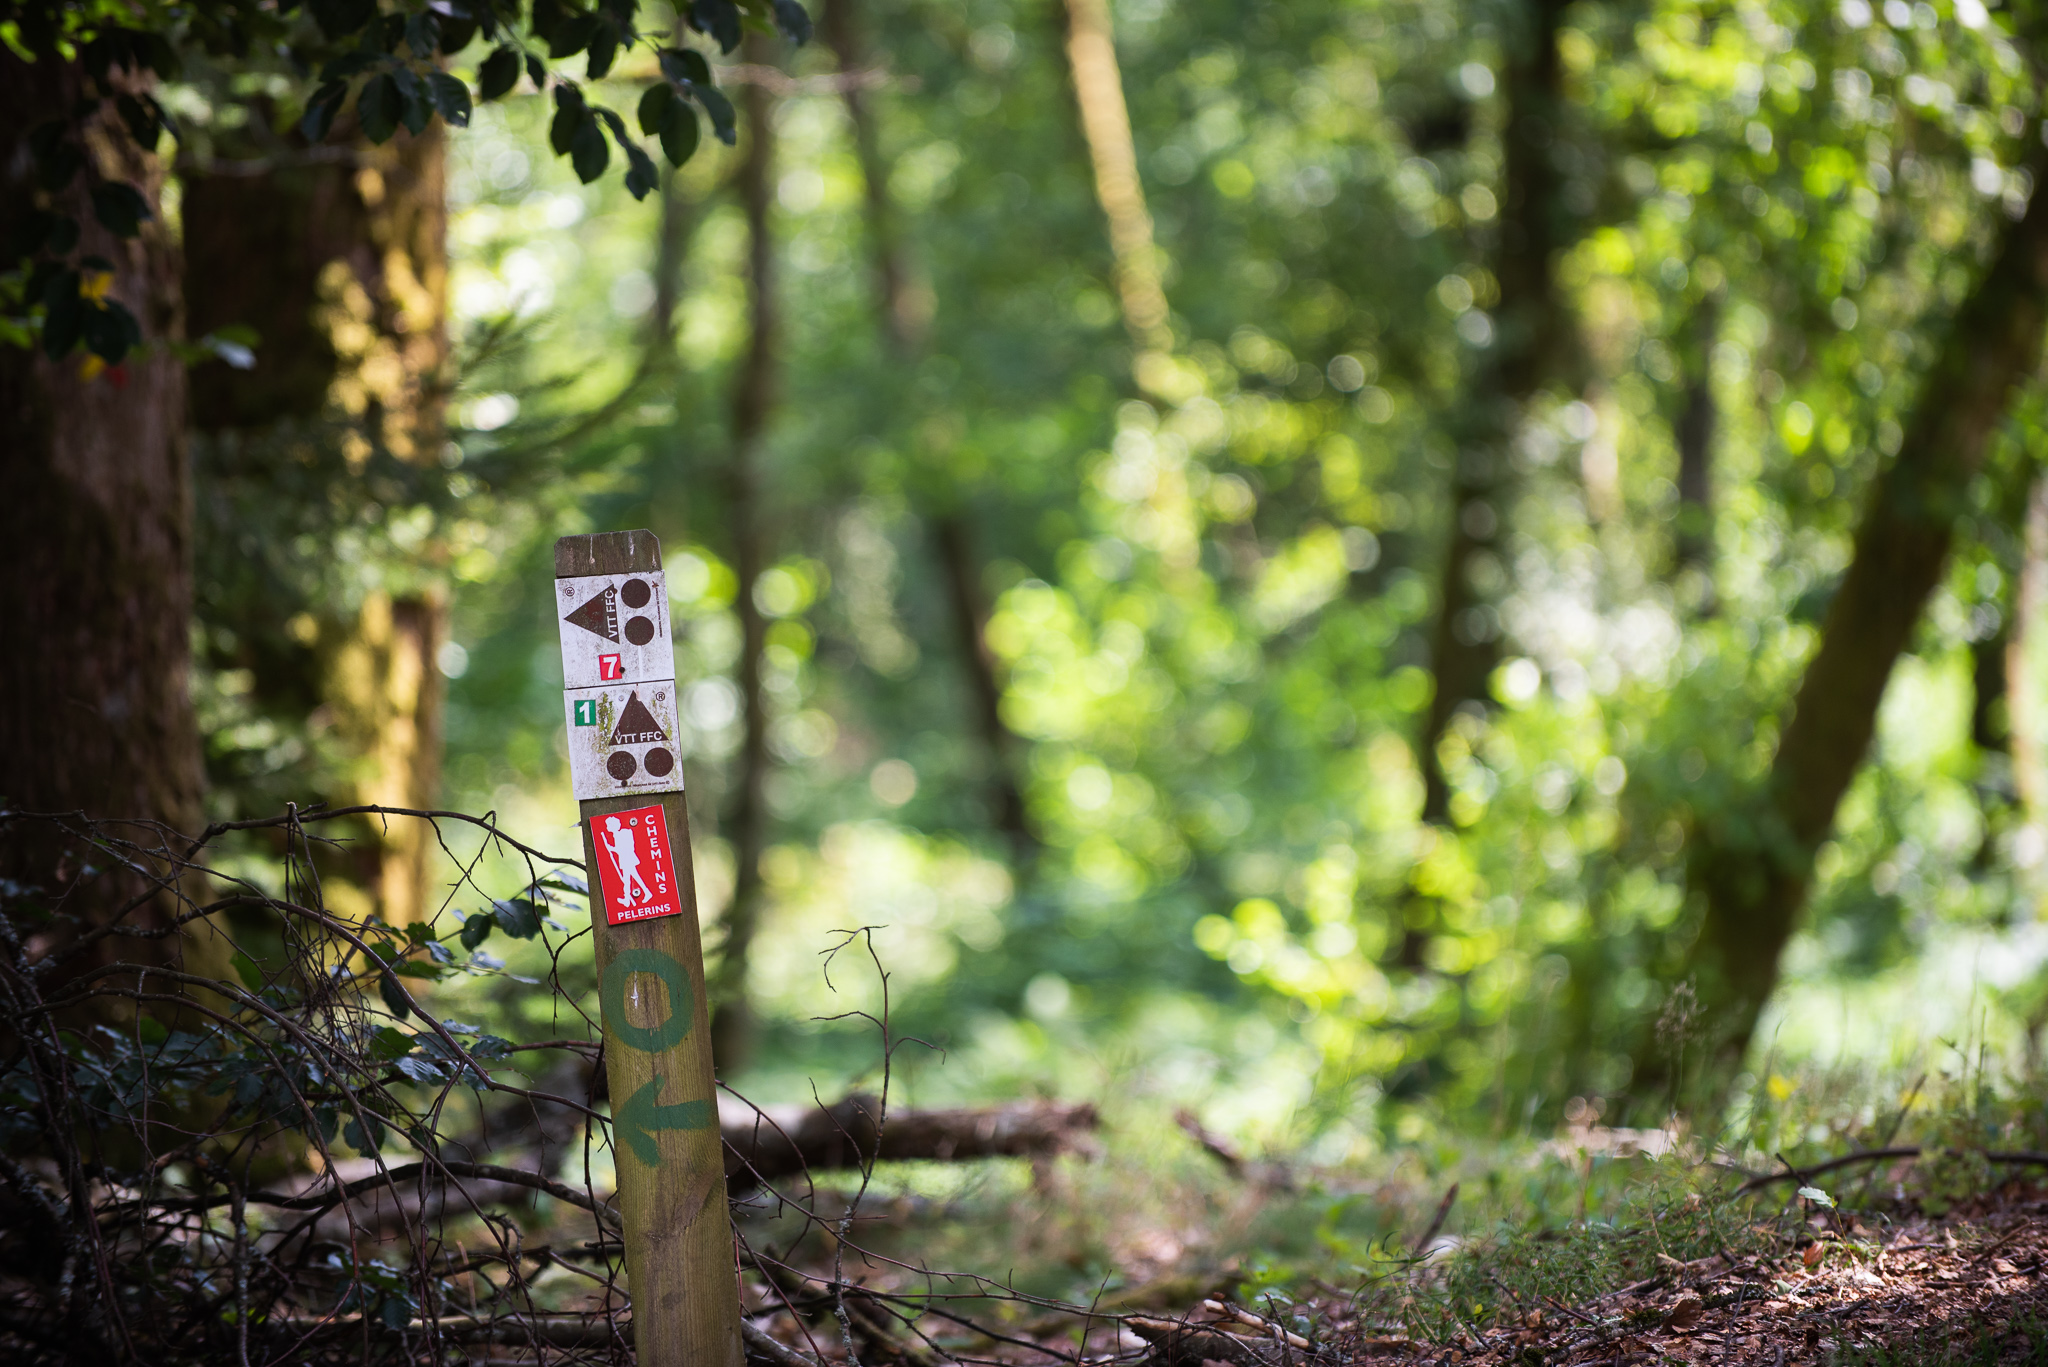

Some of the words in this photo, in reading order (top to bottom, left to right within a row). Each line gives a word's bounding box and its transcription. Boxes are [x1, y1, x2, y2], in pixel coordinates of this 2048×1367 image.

[605, 590, 616, 613] FFC
[607, 616, 618, 638] VTT
[603, 656, 617, 678] 7
[579, 701, 590, 724] 1
[615, 733, 637, 744] VTT
[640, 731, 662, 742] FFC
[645, 815, 667, 894] CHEMINS
[617, 903, 671, 921] PELERINS
